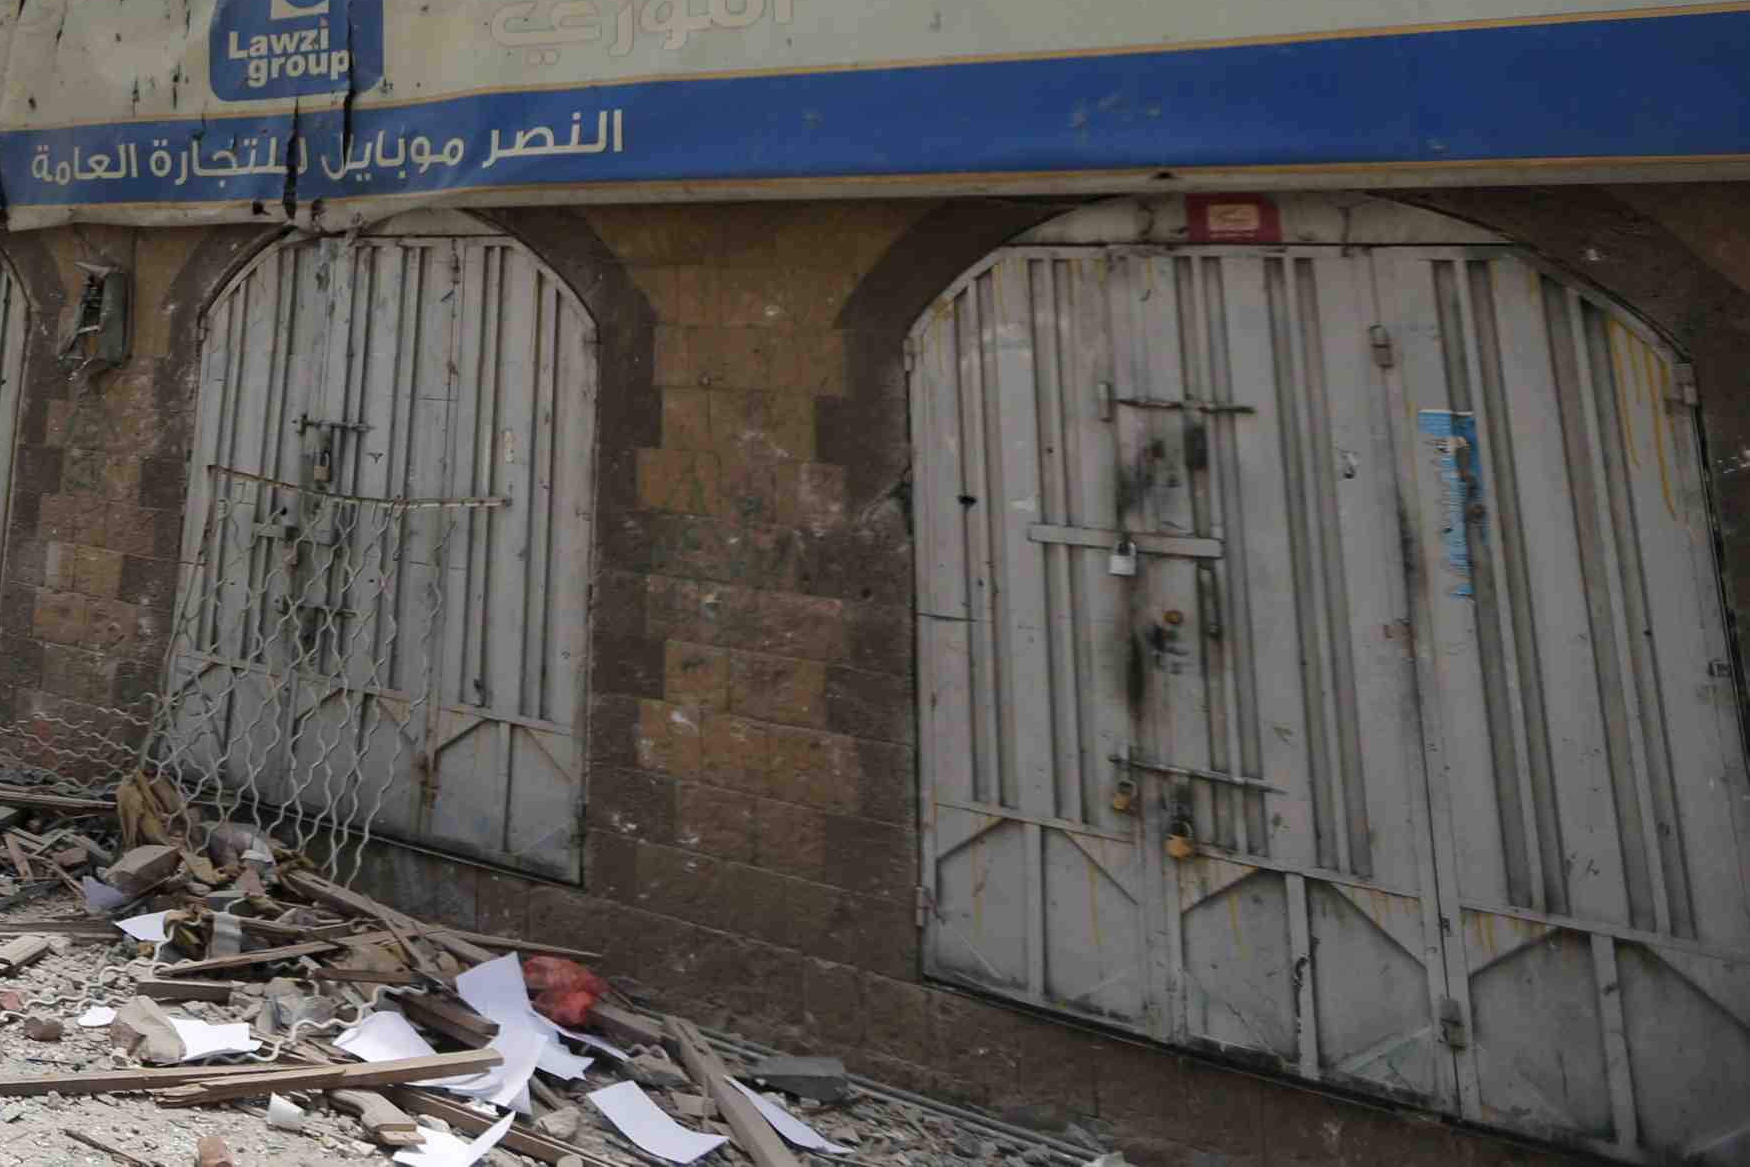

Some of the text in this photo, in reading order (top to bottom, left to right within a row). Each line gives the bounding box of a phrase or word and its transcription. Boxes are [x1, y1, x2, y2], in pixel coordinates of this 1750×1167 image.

[227, 18, 330, 60] Lawzi
[248, 47, 352, 88] group
[149, 135, 308, 188] للتجارة
[321, 125, 465, 182] موبايل
[481, 109, 623, 169] النصر
[31, 142, 139, 186] العامة
